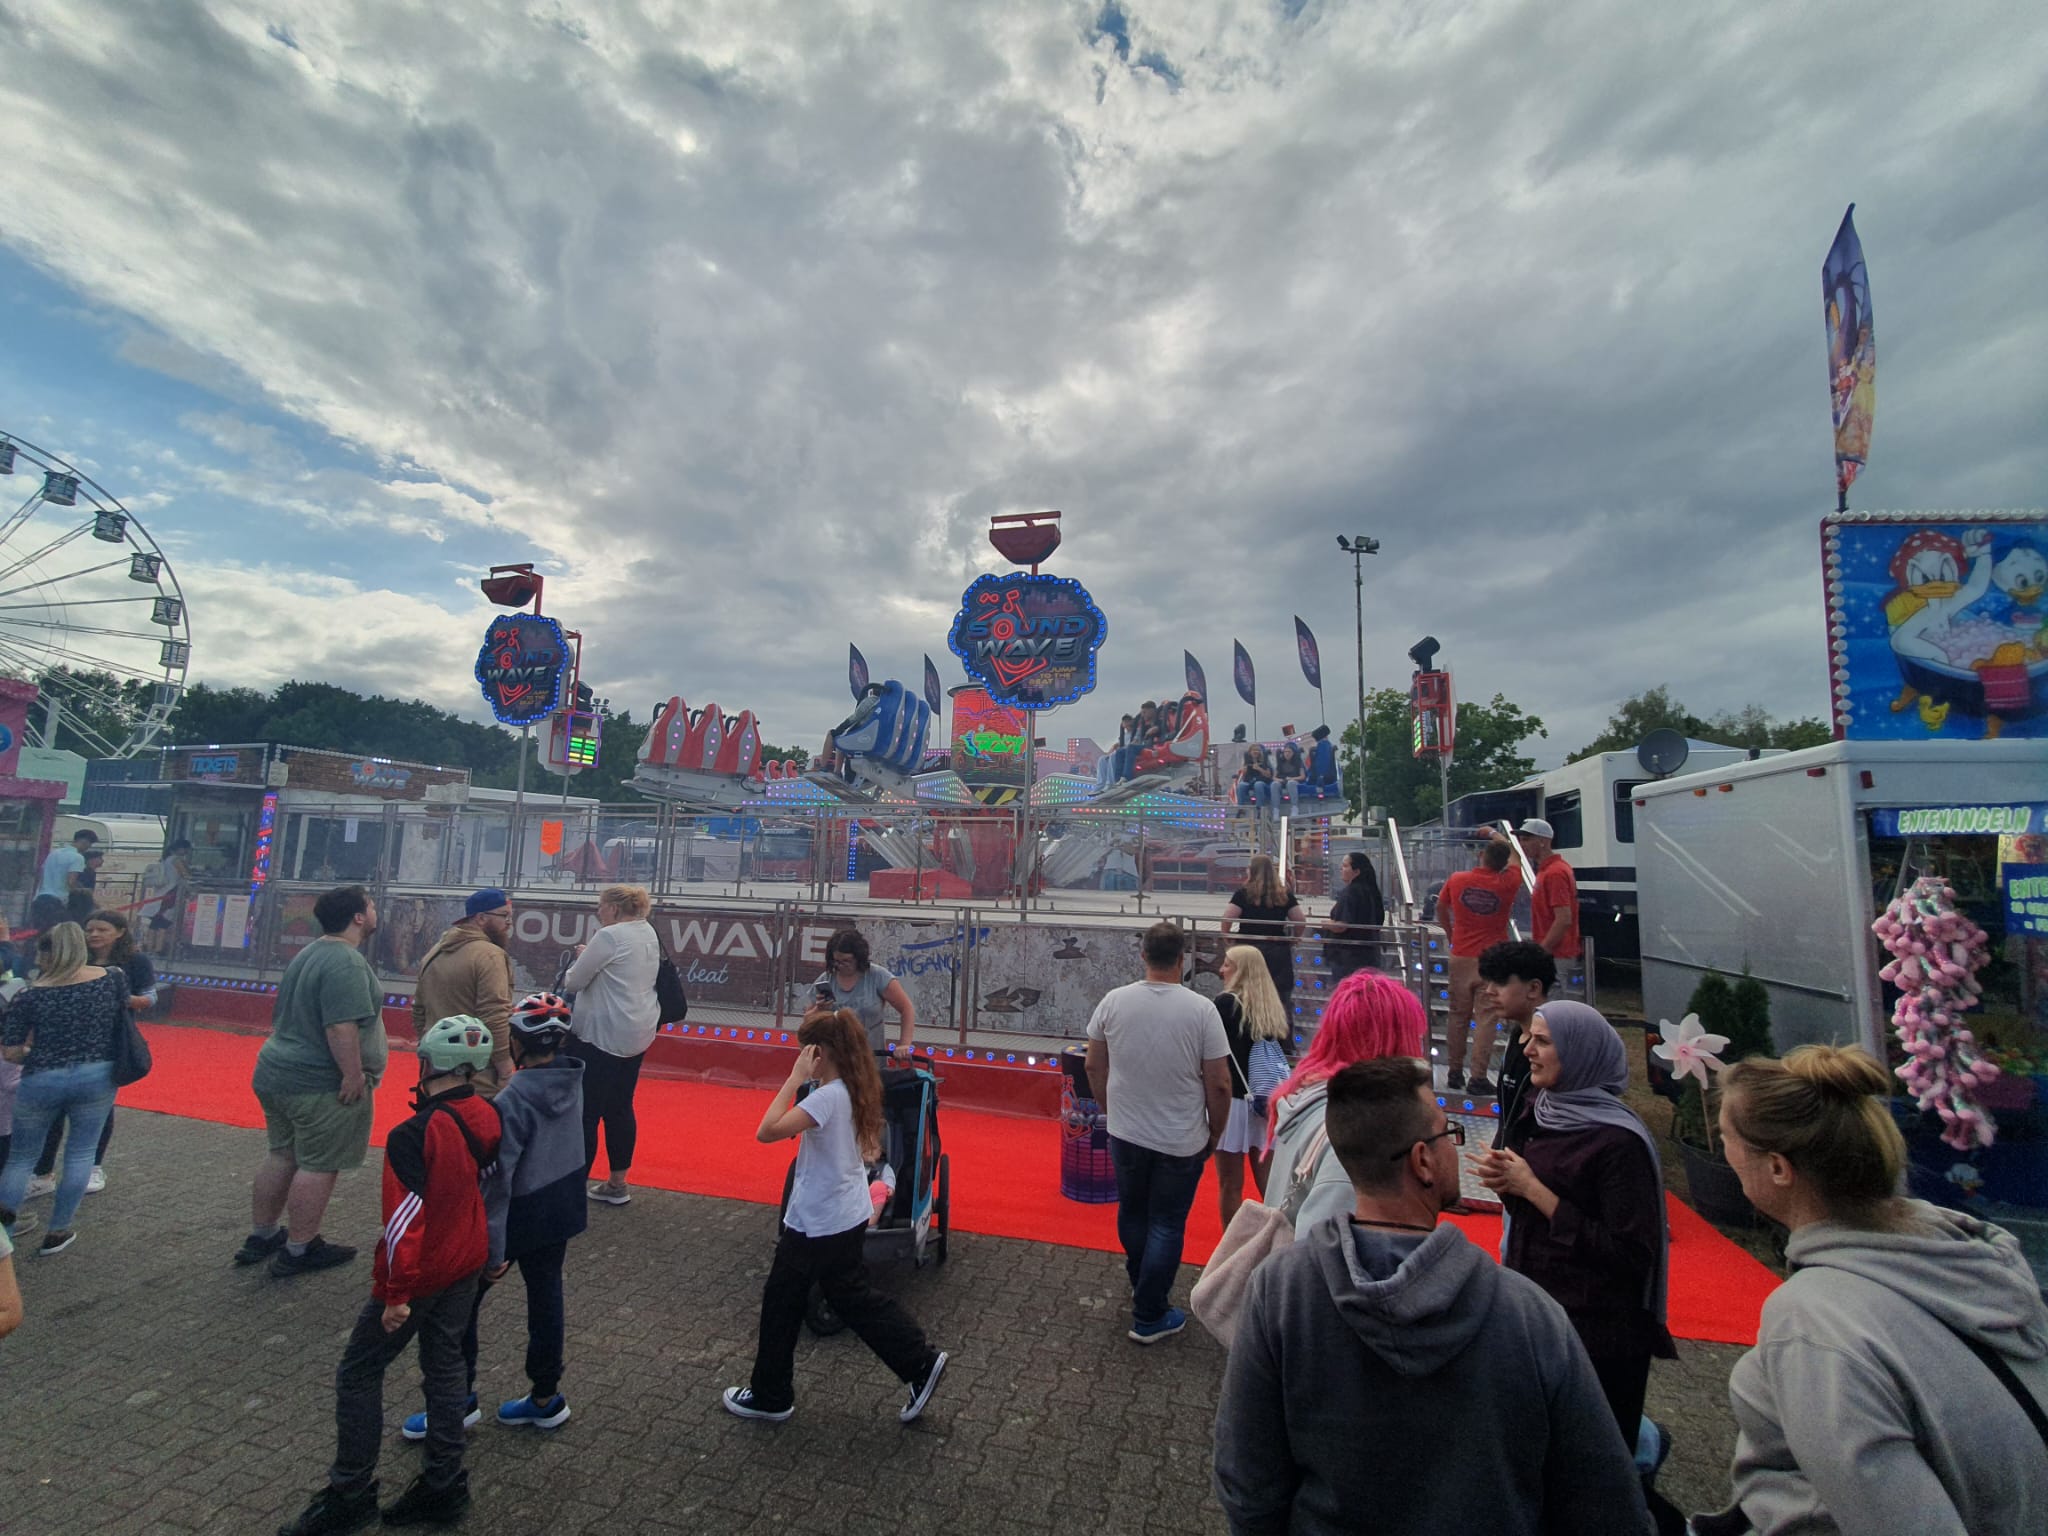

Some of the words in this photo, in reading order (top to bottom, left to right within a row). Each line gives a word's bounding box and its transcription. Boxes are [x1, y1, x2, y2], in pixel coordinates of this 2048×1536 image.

[968, 616, 1087, 639] SOUND
[976, 638, 1076, 658] WAVE
[484, 648, 557, 669] SOUND
[487, 666, 547, 684] WAVE
[191, 757, 237, 773] TICKETS
[351, 761, 411, 780] SOUND
[353, 774, 406, 790] WAVE
[1898, 806, 2032, 834] ENTENANGELN
[670, 919, 837, 963] WAVE
[687, 958, 729, 985] beat
